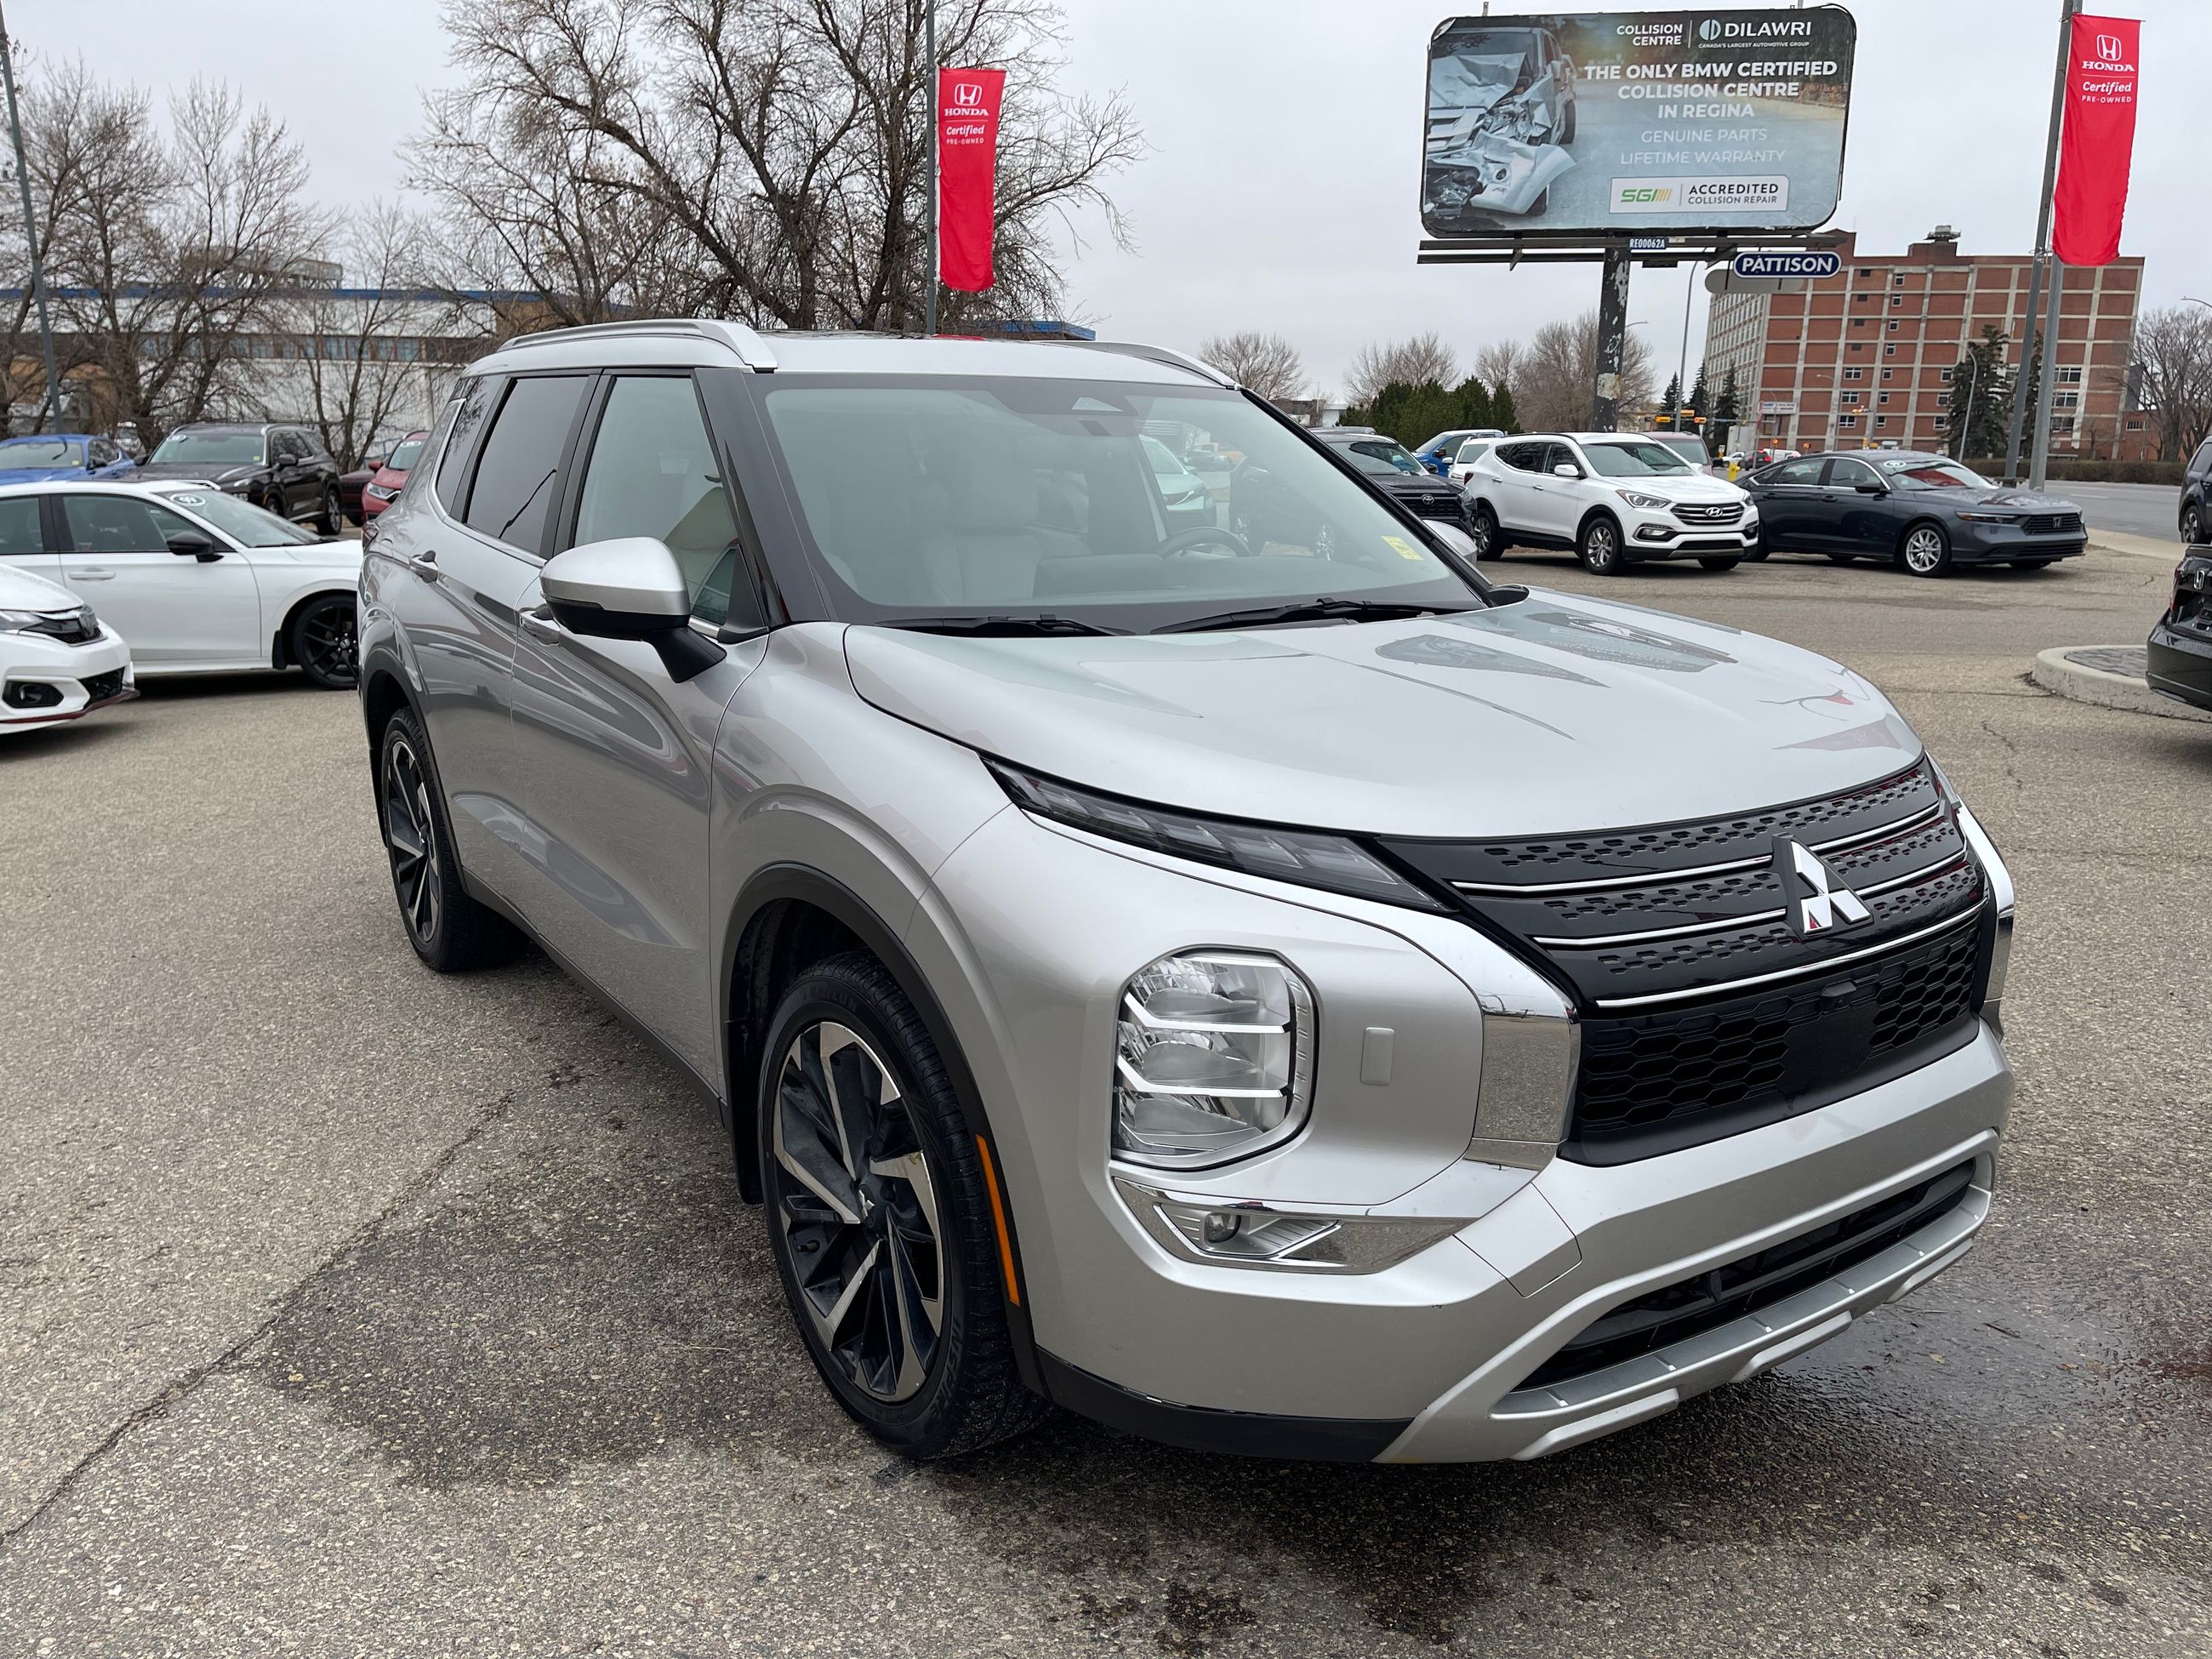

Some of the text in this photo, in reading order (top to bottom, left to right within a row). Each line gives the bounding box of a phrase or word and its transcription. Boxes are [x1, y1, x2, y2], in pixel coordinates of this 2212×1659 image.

[1616, 24, 1683, 36] COLLISION
[1725, 22, 1812, 37] DILAWRI
[1633, 36, 1682, 46] CENTRE
[1584, 61, 1838, 80] THE ONLY BMW CERTIFIED
[2082, 60, 2135, 71] HONDA
[1618, 83, 1799, 100] COLLISION CENTRE
[2083, 82, 2132, 95] Certified
[2082, 95, 2132, 103] PRE-OWNED
[944, 108, 989, 116] HONDA
[1658, 104, 1755, 118] IN REGINA
[946, 125, 985, 136] Certified
[1641, 129, 1768, 143] GENUINE PARTS
[1621, 150, 1786, 164] LIFETIME WARRANTY
[1621, 189, 1657, 202] SGI
[1689, 184, 1778, 195] ACCREDITED
[1630, 238, 1665, 248] RE00062A
[1742, 257, 1833, 272] PATTISON
